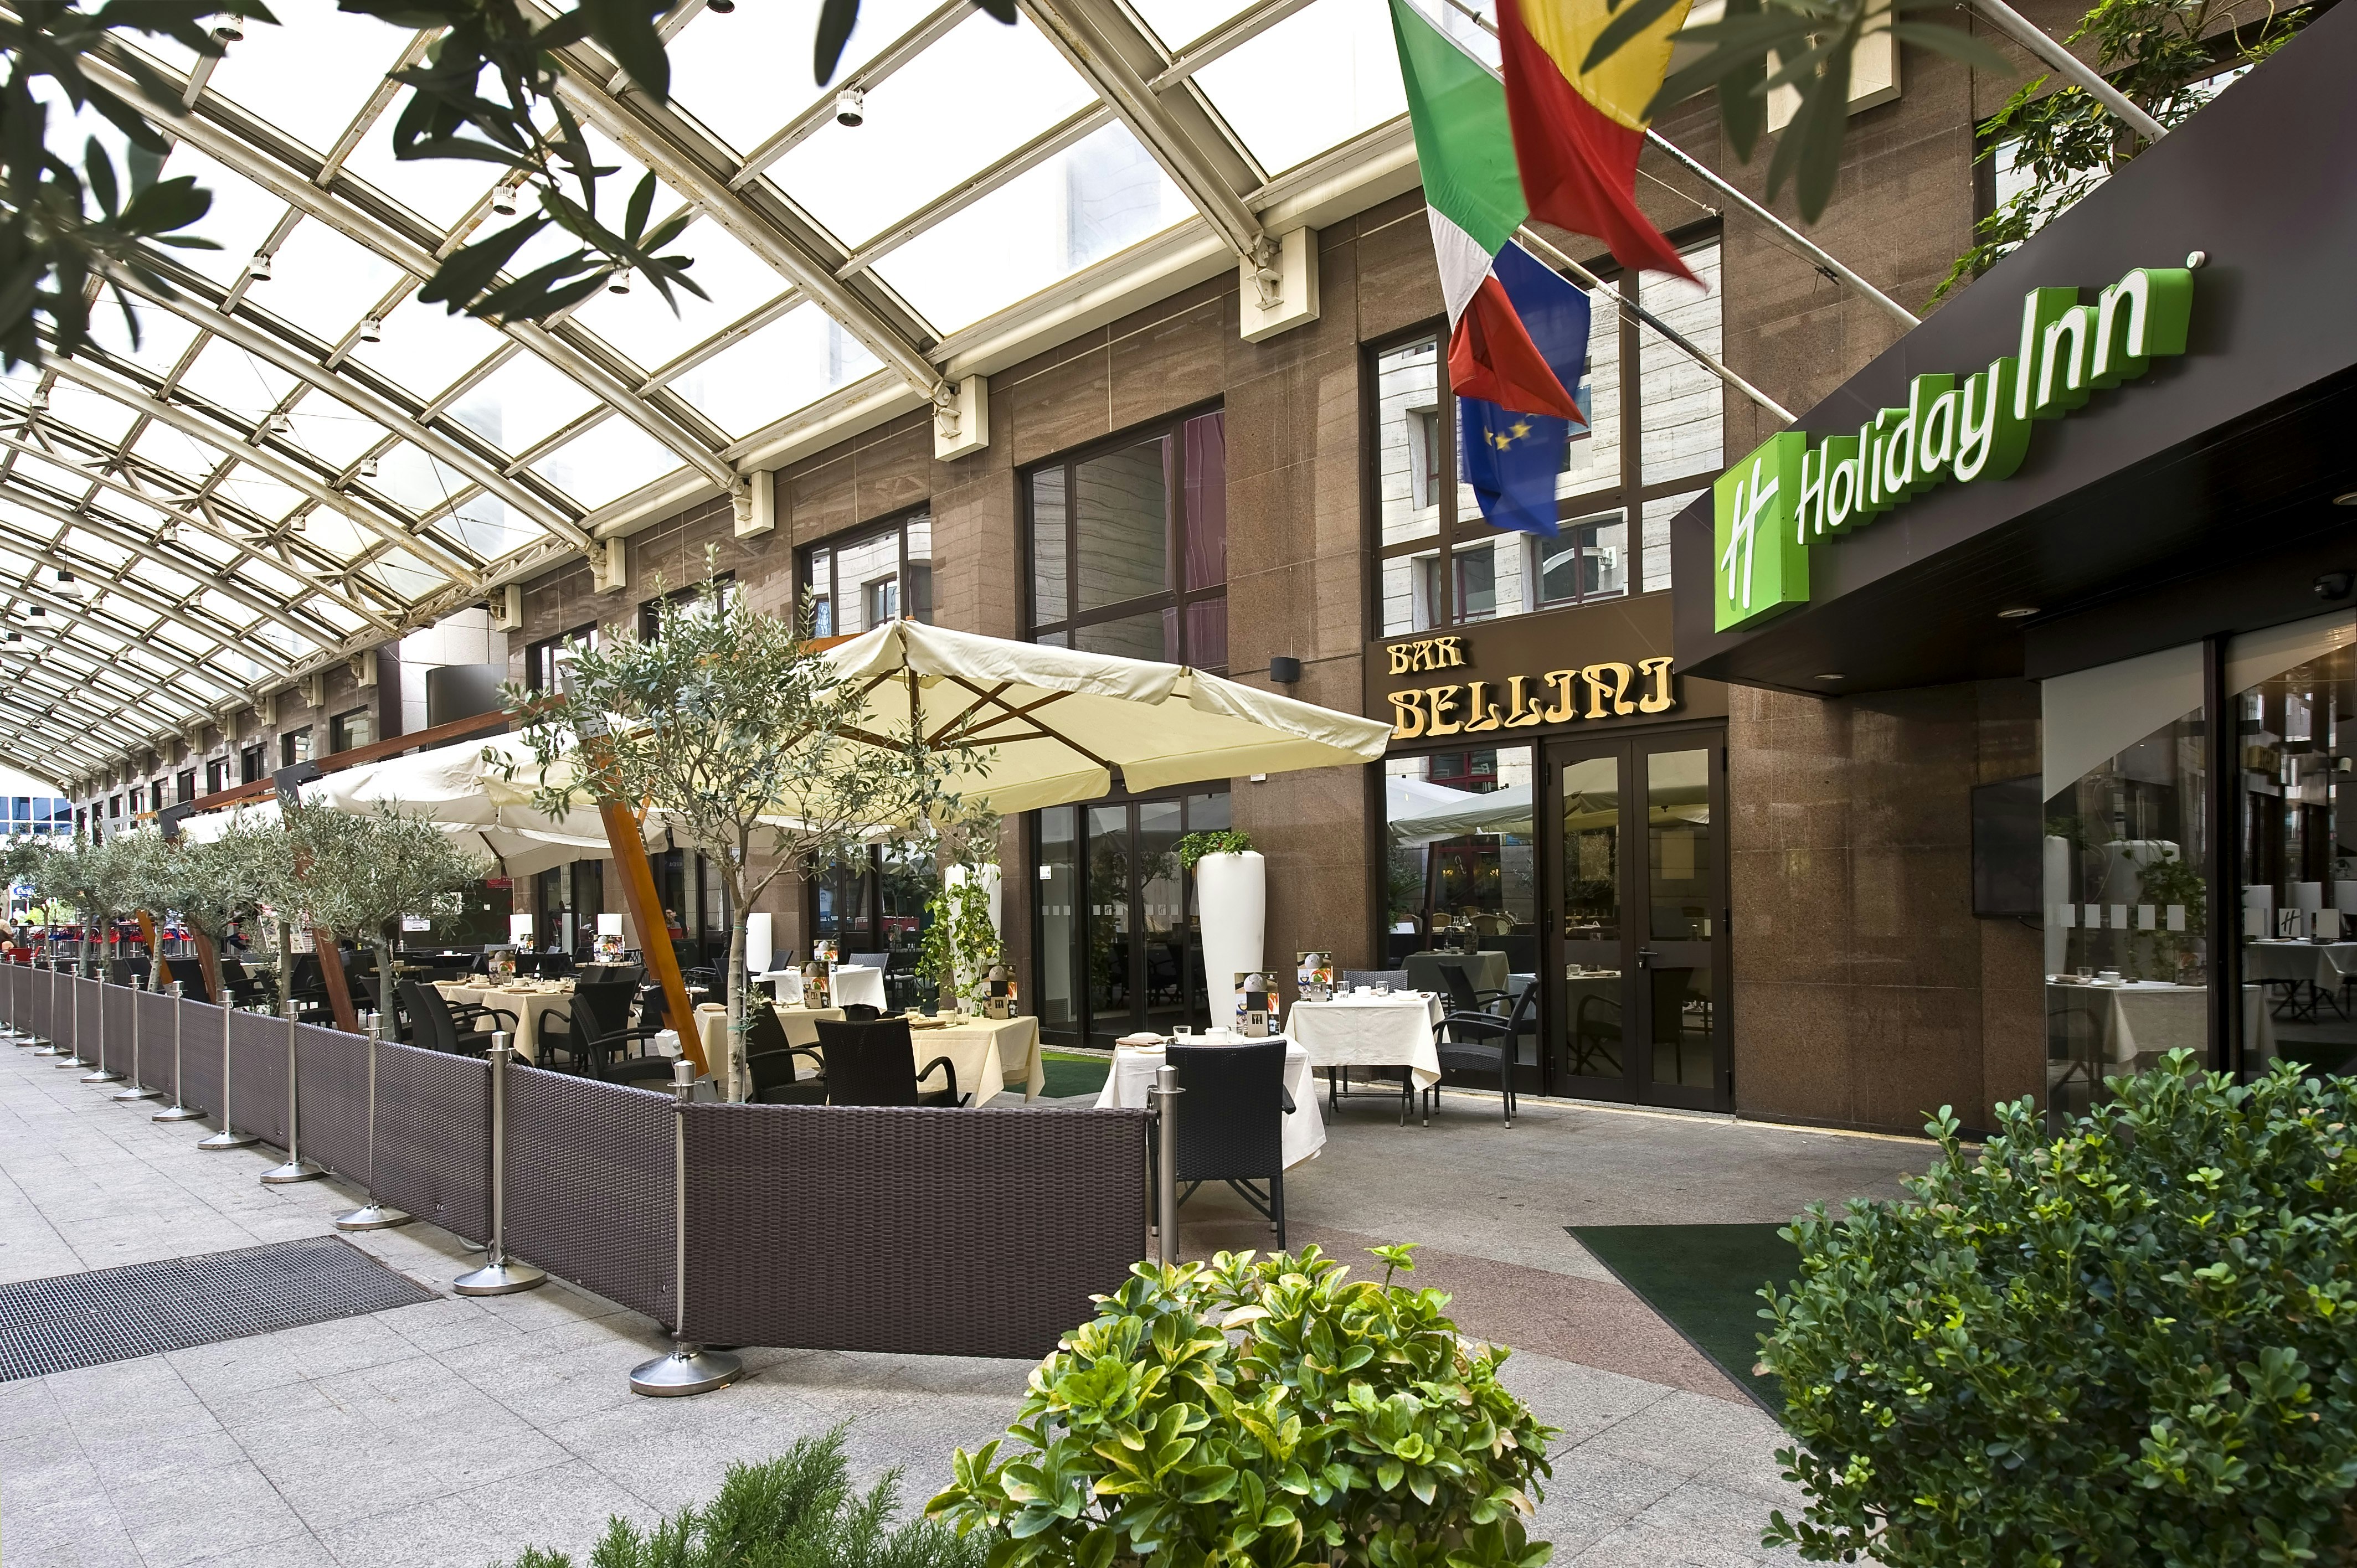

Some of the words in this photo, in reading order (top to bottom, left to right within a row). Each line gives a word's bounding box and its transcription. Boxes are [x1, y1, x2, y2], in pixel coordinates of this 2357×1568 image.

[1795, 357, 2001, 545] Holiday
[2014, 268, 2149, 420] Inn
[1386, 636, 1462, 675] BAR
[1387, 657, 1675, 740] BELLINI
